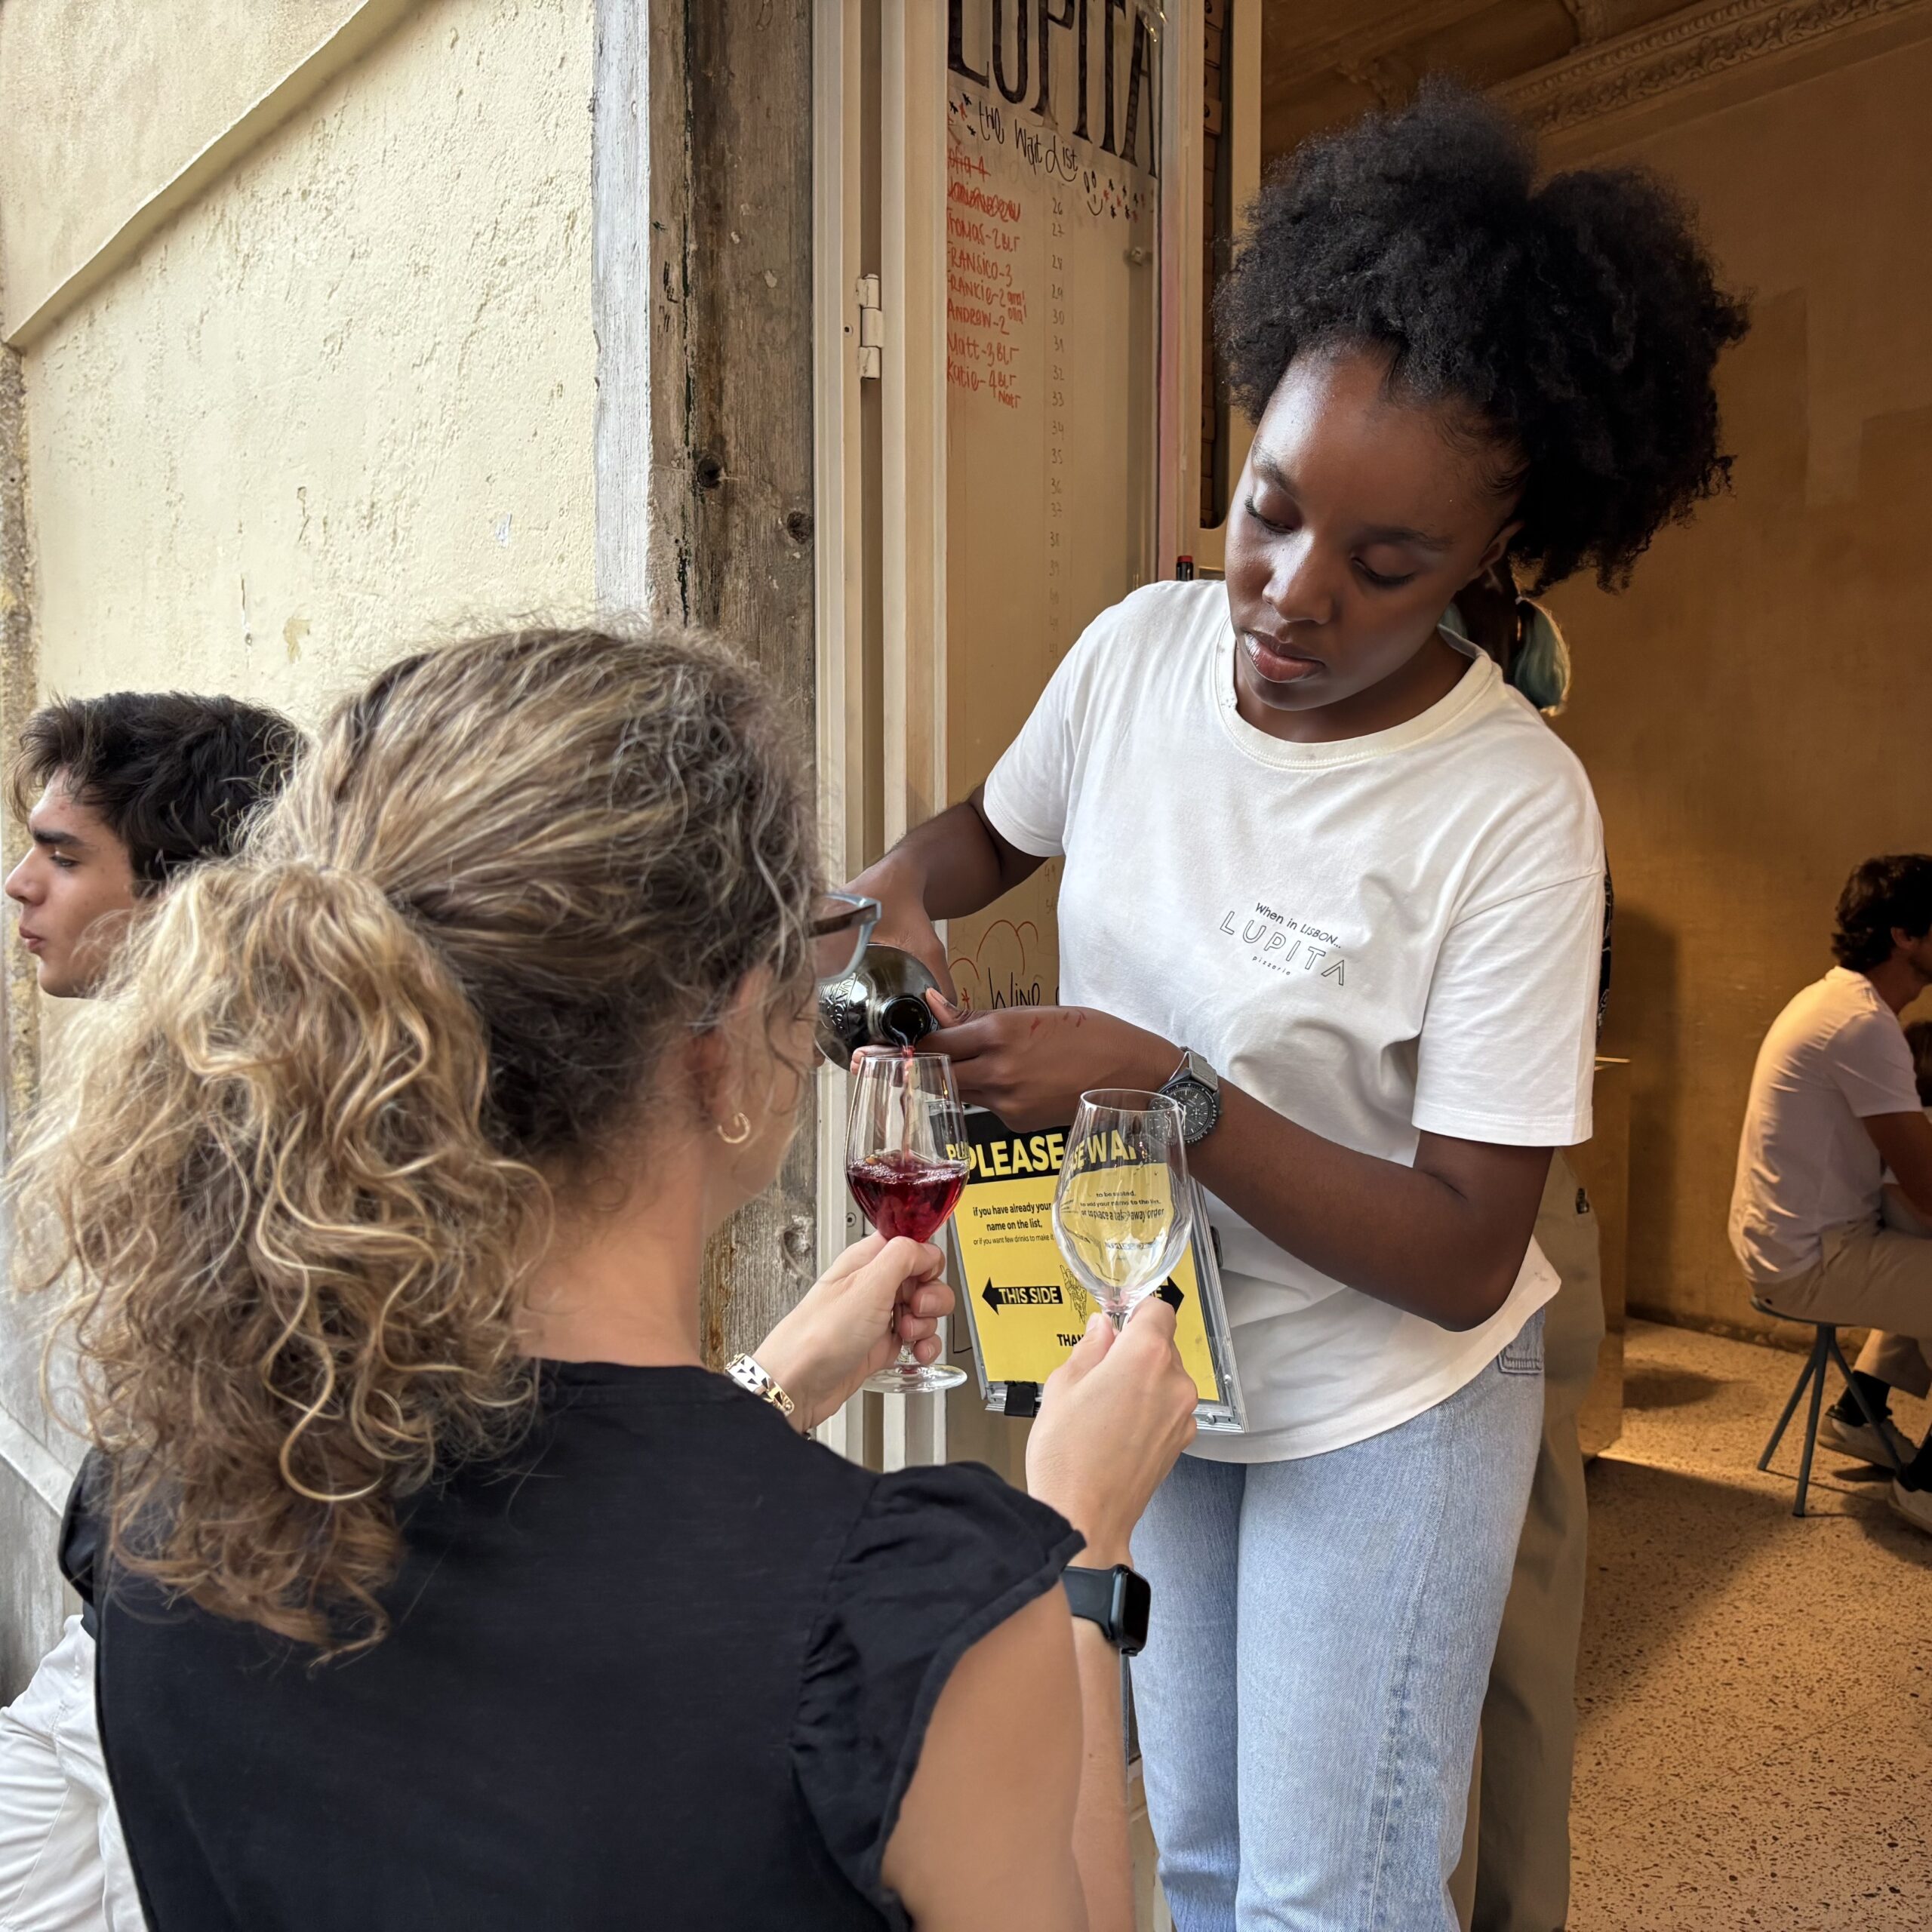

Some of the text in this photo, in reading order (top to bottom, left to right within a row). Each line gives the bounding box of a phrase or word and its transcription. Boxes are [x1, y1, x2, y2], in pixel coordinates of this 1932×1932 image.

[1052, 197, 1063, 215] 26
[1053, 308, 1065, 325] 30
[1052, 391, 1064, 407] 33
[1255, 903, 1284, 924] When
[1287, 918, 1298, 931] in
[1219, 910, 1345, 986] LUPITA
[973, 1202, 1052, 1218] if you have already your
[986, 1222, 1007, 1232] name
[1007, 1221, 1017, 1230] on
[1017, 1219, 1029, 1229] the
[1014, 1235, 1029, 1243] drinks
[1035, 1234, 1050, 1242] make
[998, 1287, 1060, 1304] THIS SIDE
